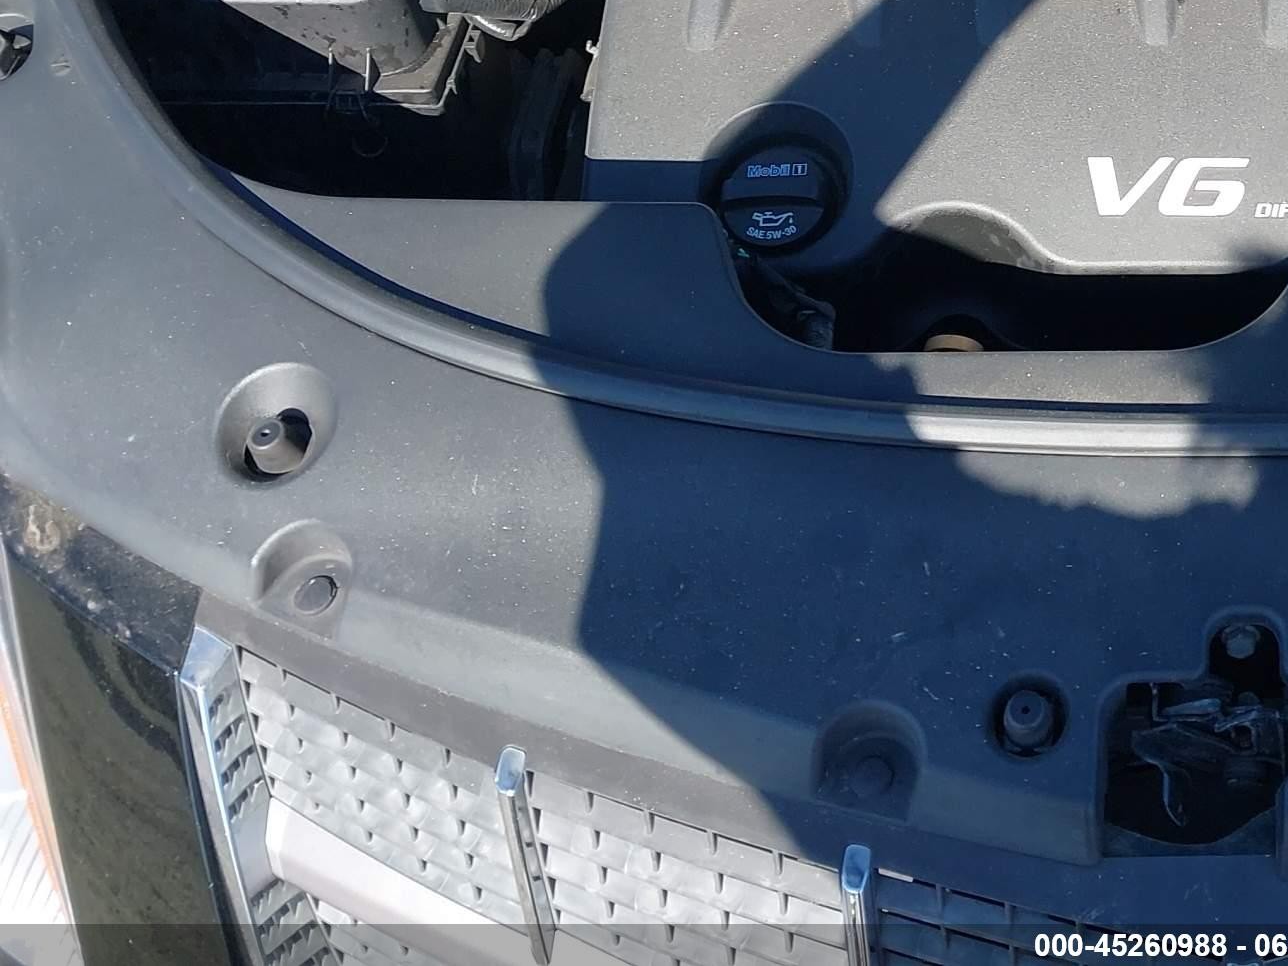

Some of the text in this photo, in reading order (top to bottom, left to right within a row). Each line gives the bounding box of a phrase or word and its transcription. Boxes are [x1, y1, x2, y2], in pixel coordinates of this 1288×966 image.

[747, 164, 791, 178] Mobil
[1087, 156, 1251, 217] V6
[746, 226, 766, 240] SAE
